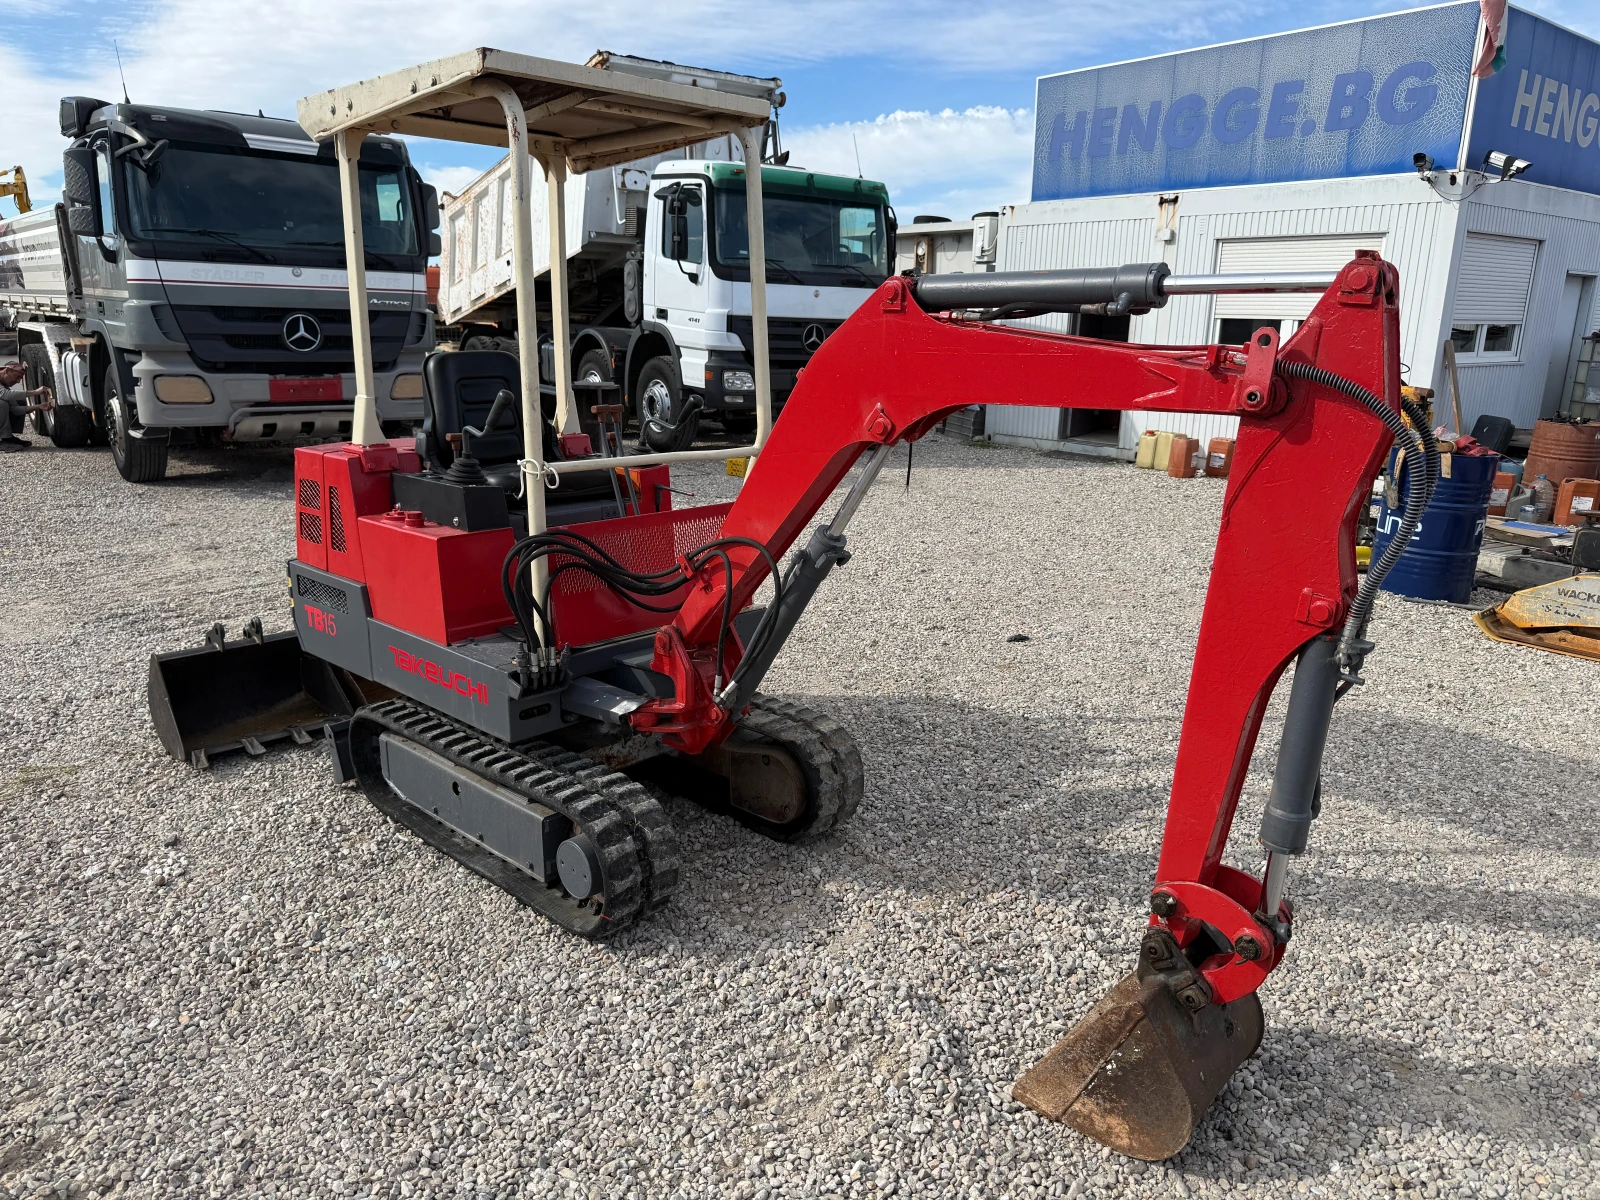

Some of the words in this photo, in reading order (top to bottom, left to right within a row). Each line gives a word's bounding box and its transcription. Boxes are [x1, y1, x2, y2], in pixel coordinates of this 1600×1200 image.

[1048, 61, 1439, 162] HENGGE.BG
[1510, 68, 1600, 149] HENG
[320, 273, 402, 288] BAUOFFE
[304, 604, 337, 637] TB15
